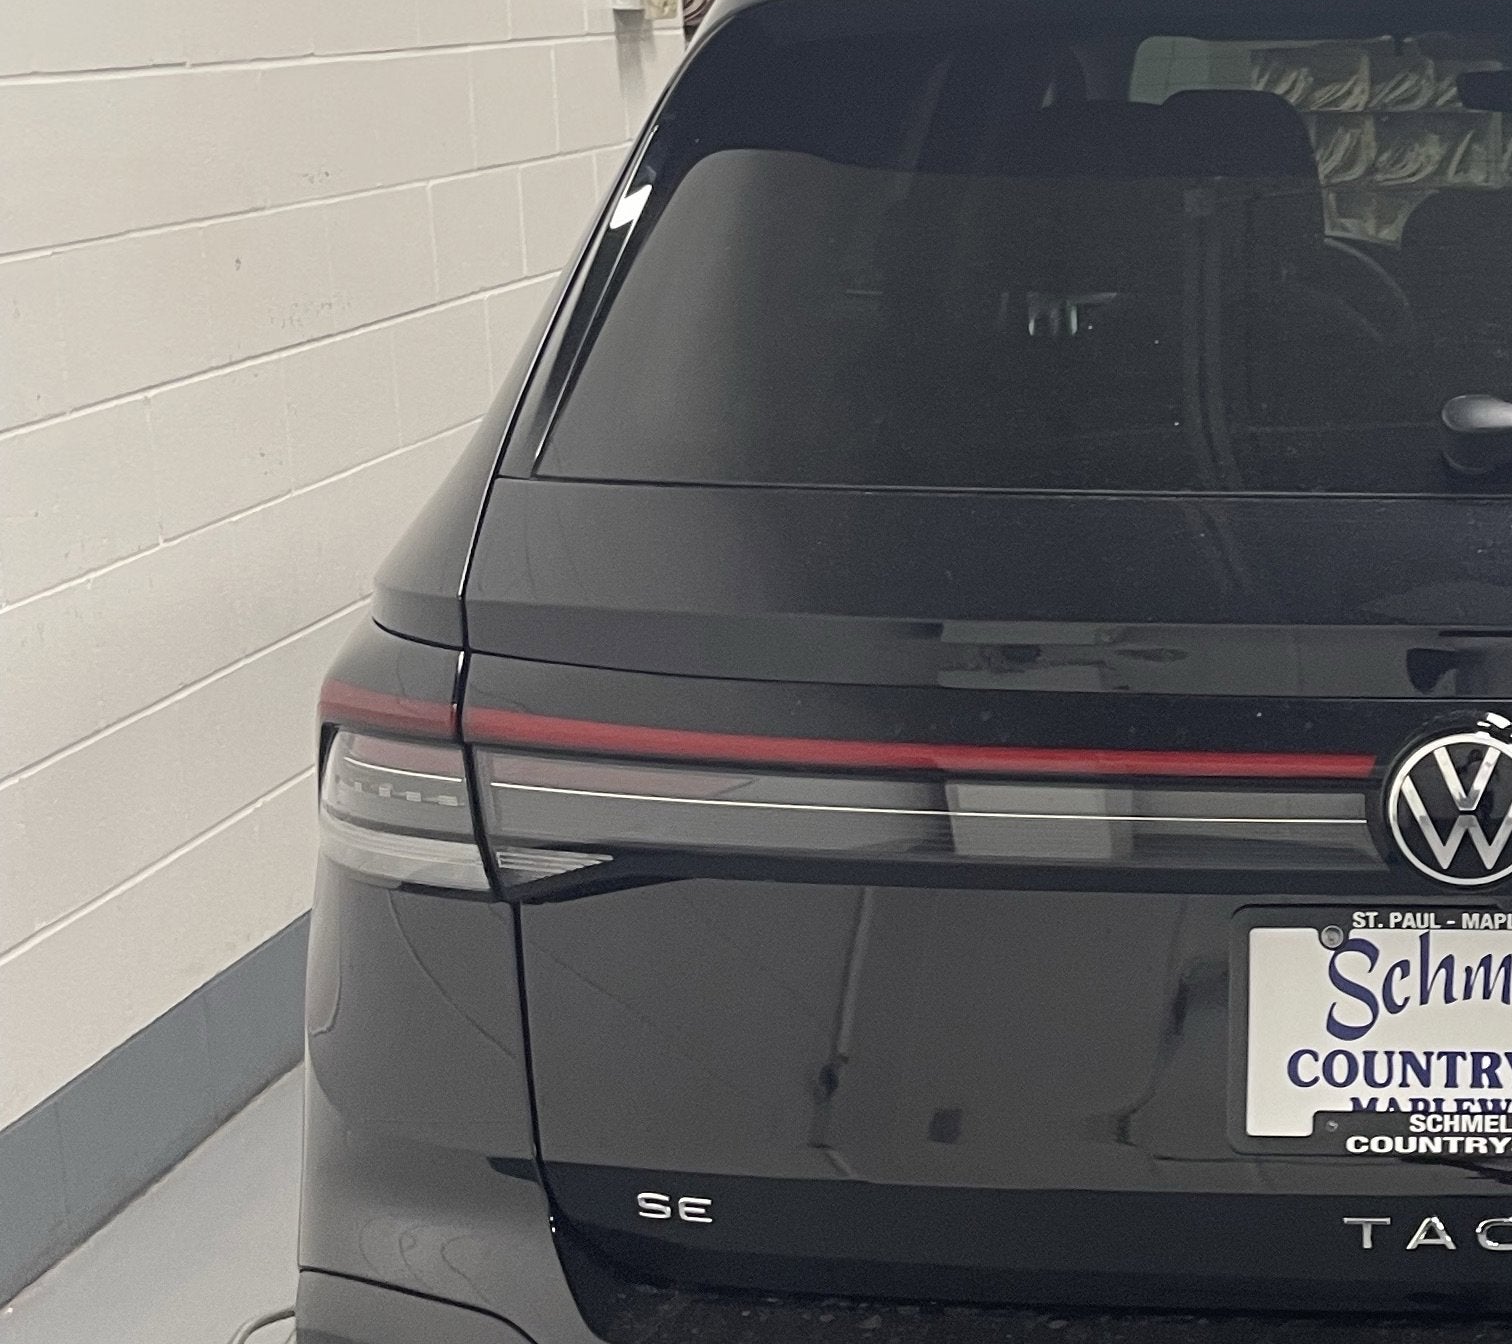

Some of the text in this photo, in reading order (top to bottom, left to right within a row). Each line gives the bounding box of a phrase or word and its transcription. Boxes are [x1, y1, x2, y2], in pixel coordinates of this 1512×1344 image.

[1352, 911, 1384, 929] ST.
[1389, 912, 1442, 929] PAUL
[636, 1191, 714, 1224] SE
